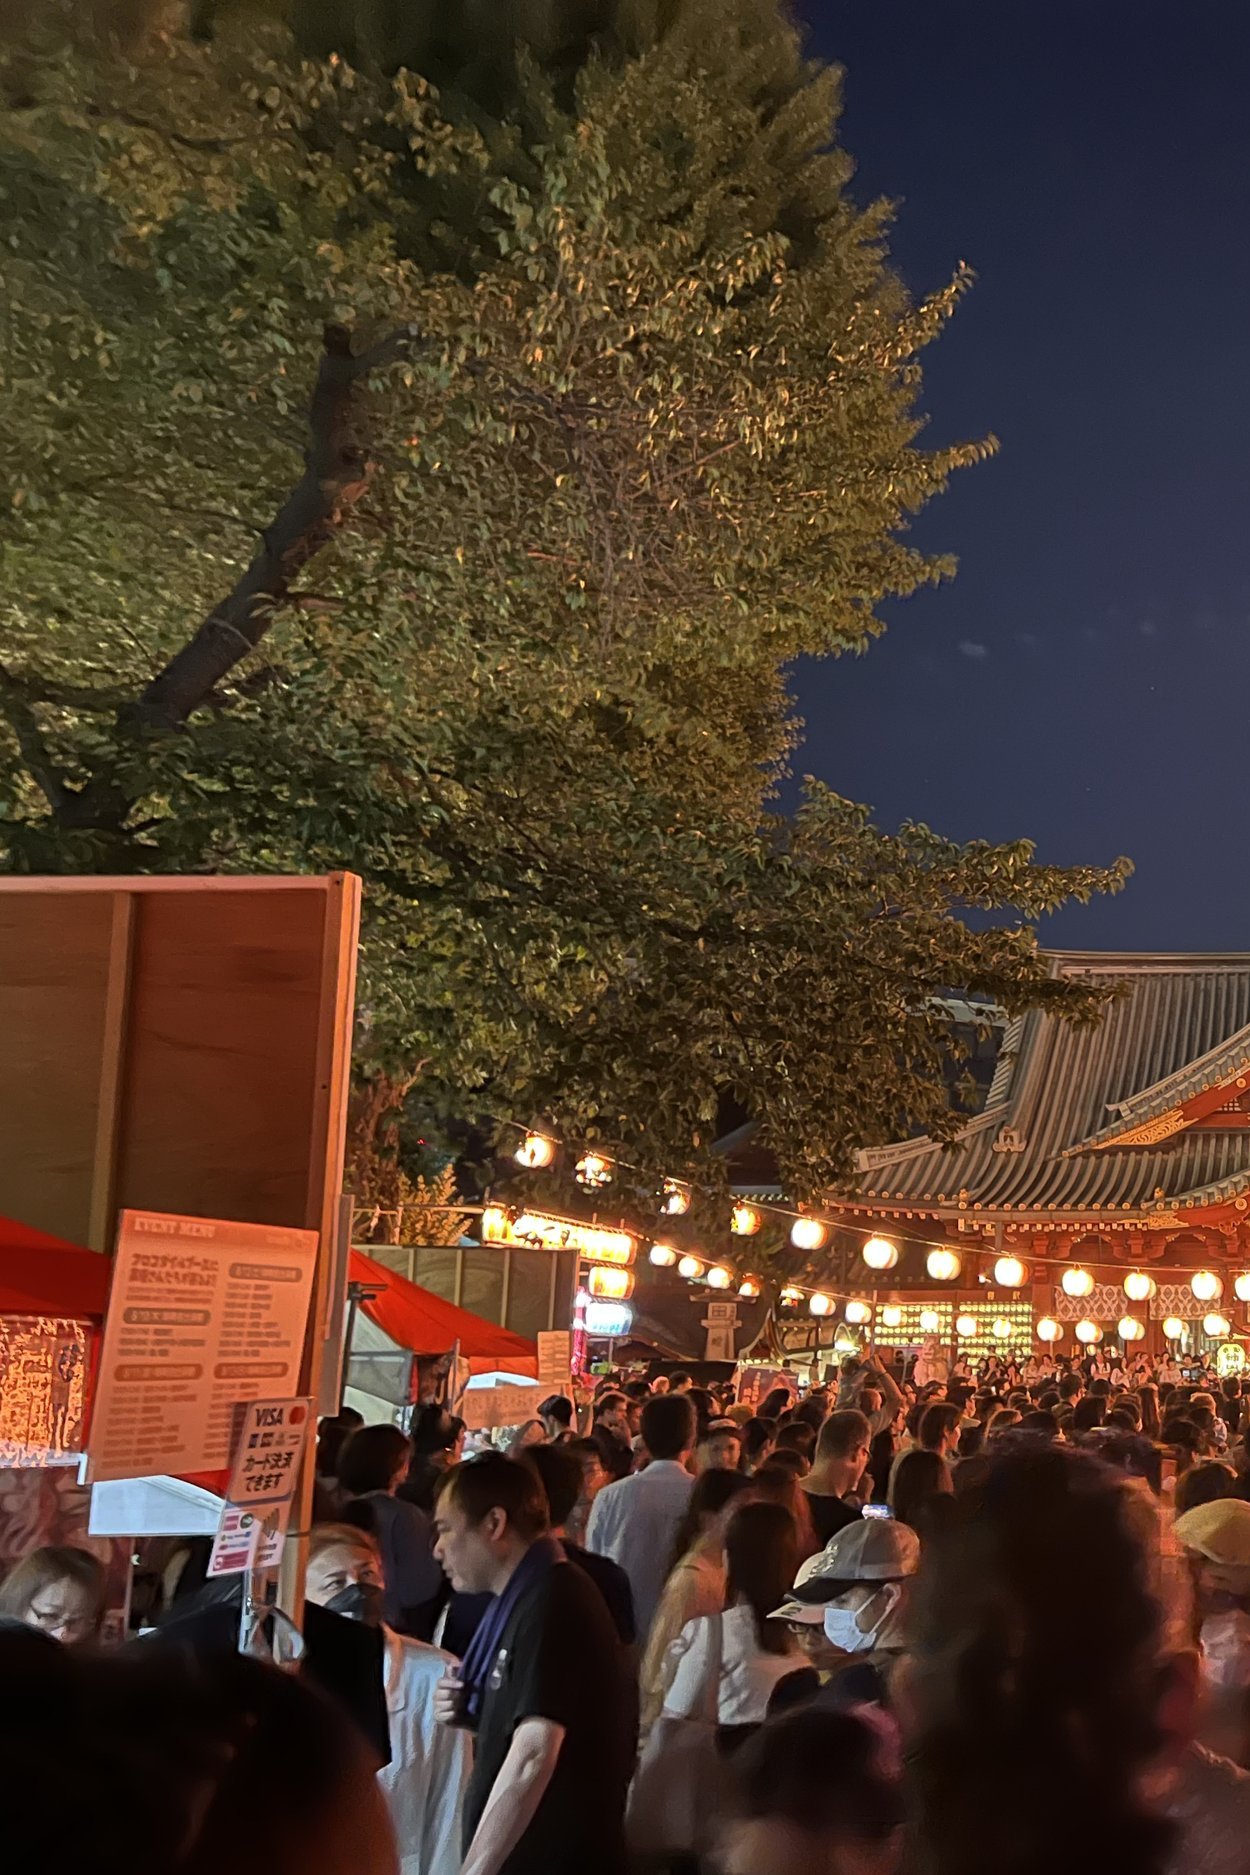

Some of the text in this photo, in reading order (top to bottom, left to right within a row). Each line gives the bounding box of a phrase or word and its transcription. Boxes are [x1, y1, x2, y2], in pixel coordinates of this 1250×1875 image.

[255, 1407, 284, 1427] VISA
[242, 1451, 295, 1473] カード決済
[245, 1472, 284, 1492] できます
